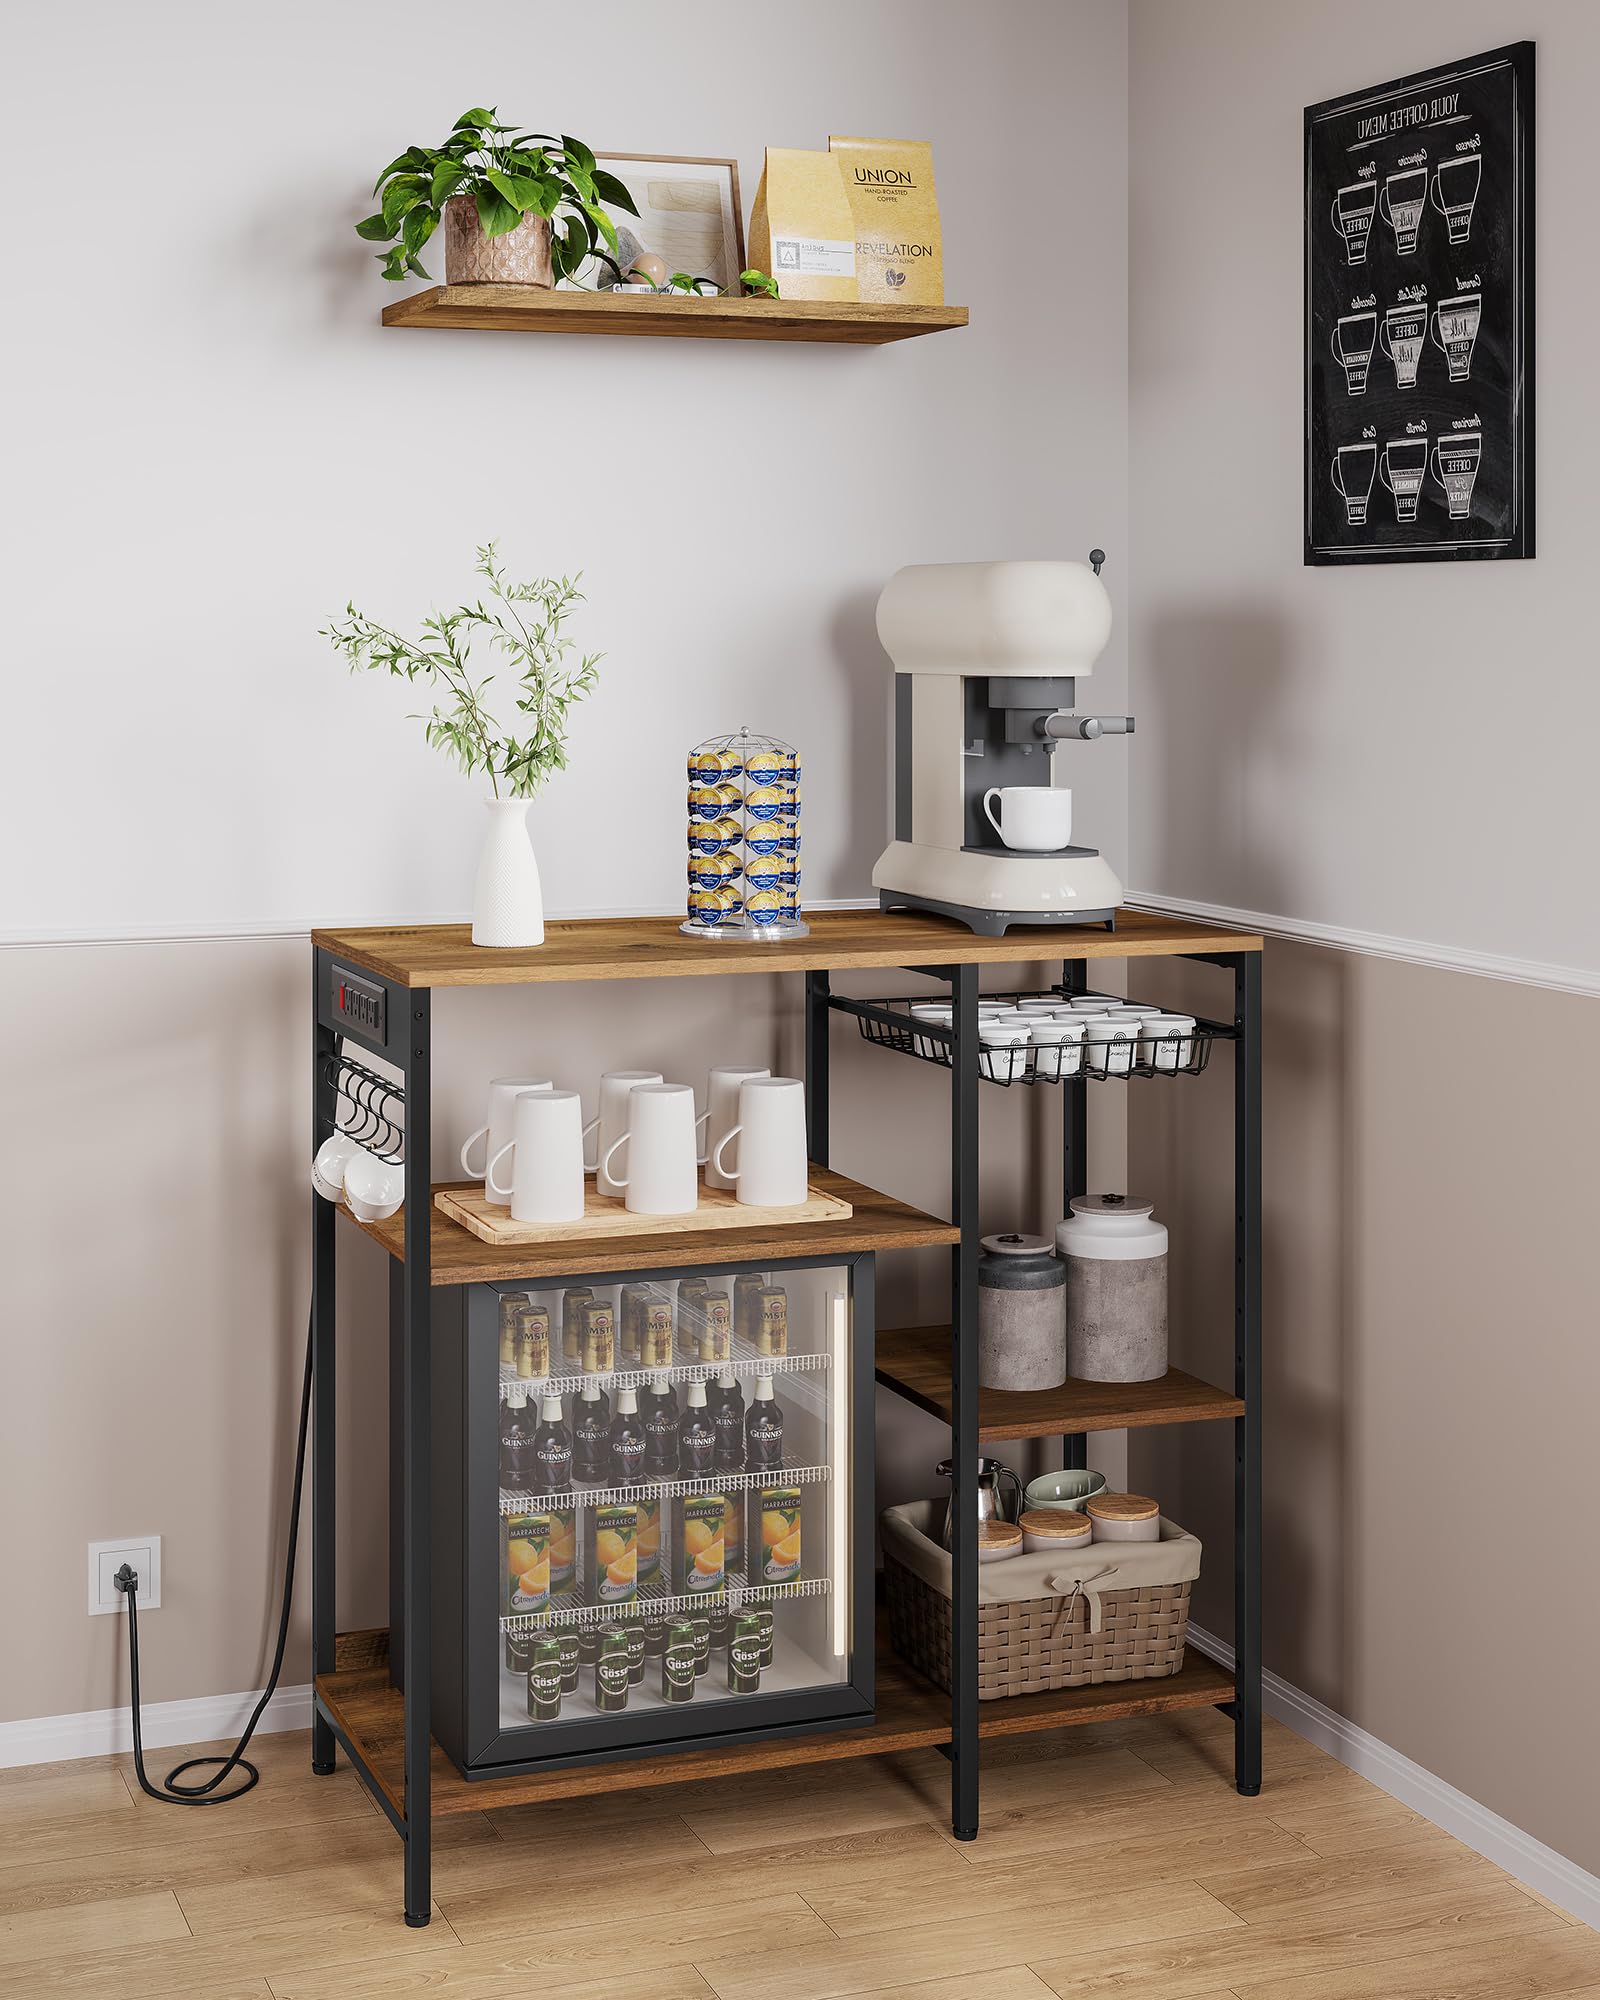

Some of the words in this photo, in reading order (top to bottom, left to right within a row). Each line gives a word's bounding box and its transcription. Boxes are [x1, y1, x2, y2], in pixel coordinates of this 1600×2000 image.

[855, 168, 912, 184] UNION
[865, 188, 908, 196] HAND-ROASTED
[856, 242, 932, 257] REVELATION
[763, 1499, 800, 1509] MARRAKECH
[686, 1508, 724, 1517] MARRAKECH
[598, 1517, 637, 1527] MARRAKECH
[510, 1527, 550, 1537] MARRAKECH
